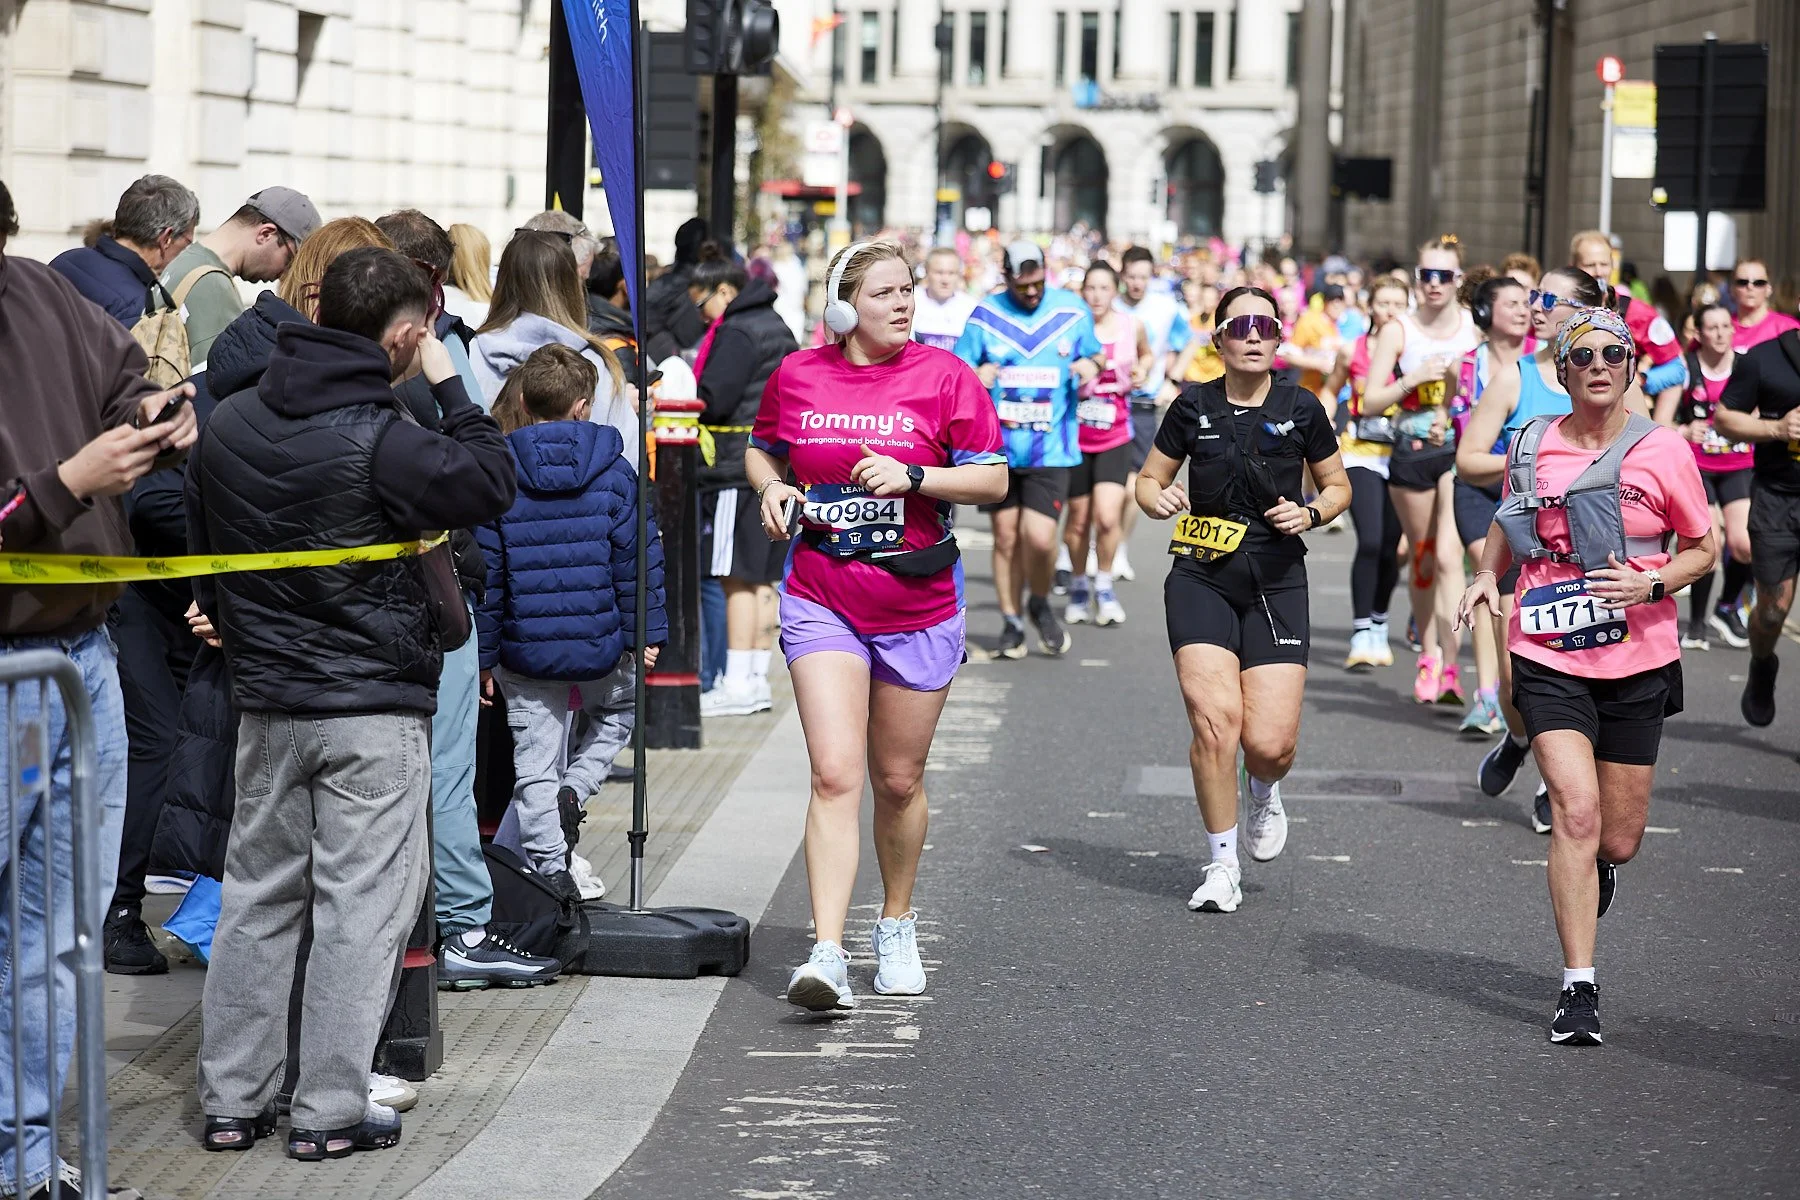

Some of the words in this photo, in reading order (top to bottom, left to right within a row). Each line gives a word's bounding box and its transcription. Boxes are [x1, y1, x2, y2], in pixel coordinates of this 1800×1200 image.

[800, 409, 915, 436] Tommy's
[807, 437, 847, 445] pregnancy
[847, 436, 863, 445] and
[864, 437, 885, 446] baby
[887, 438, 914, 449] charity
[840, 486, 865, 494] LEAH
[811, 500, 898, 523] 10984
[1181, 517, 1239, 545] 12017
[1555, 583, 1581, 594] KYDD
